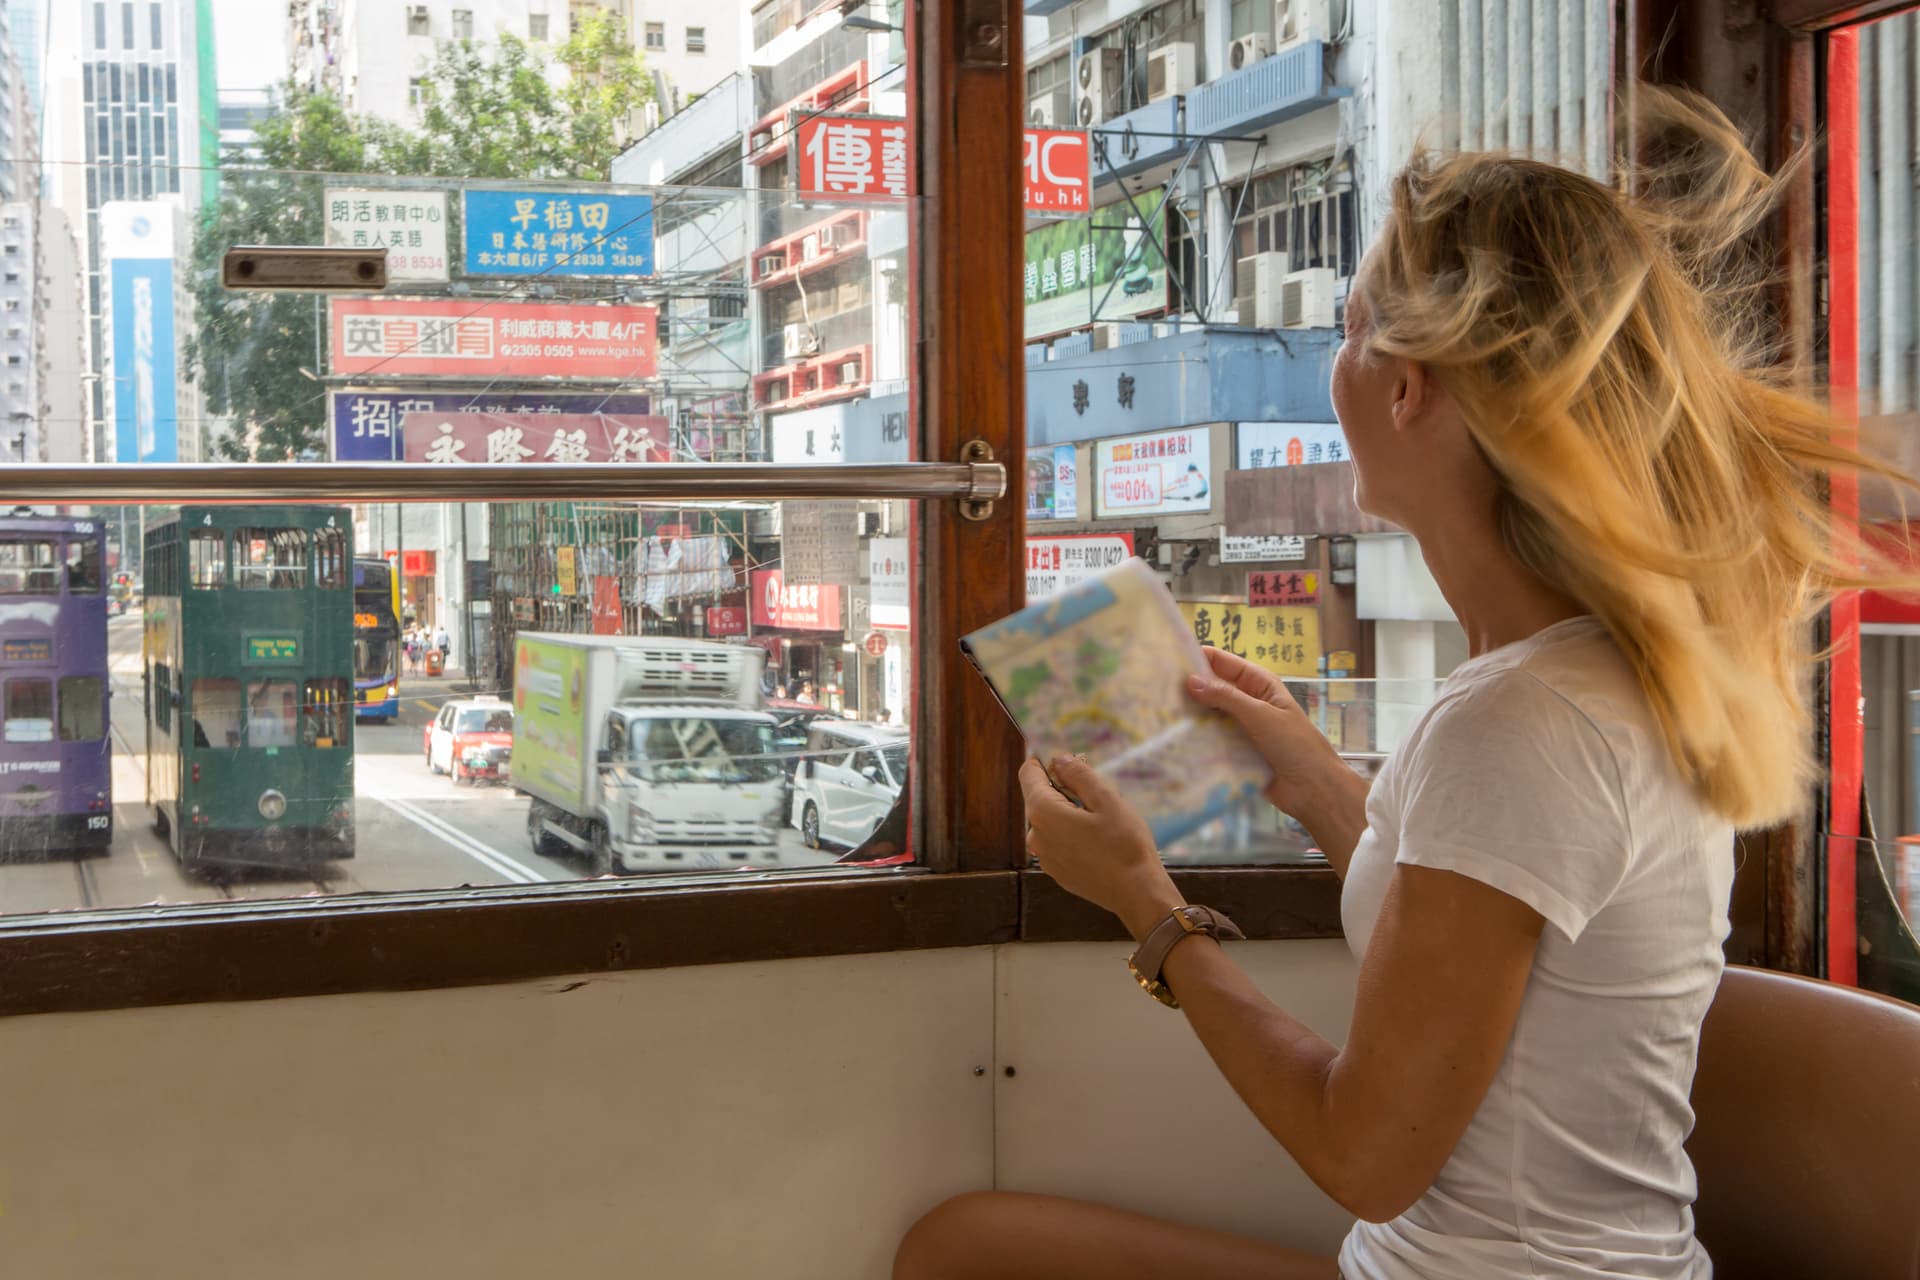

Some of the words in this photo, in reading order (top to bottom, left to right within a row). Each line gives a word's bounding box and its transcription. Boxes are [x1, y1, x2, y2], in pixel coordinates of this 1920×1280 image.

[510, 199, 609, 230] 早稻田
[511, 344, 542, 357] 2305
[544, 345, 574, 358] 0505
[203, 513, 212, 526] 4
[327, 515, 335, 527] 4
[74, 522, 94, 533] 150
[88, 816, 108, 829] 150
